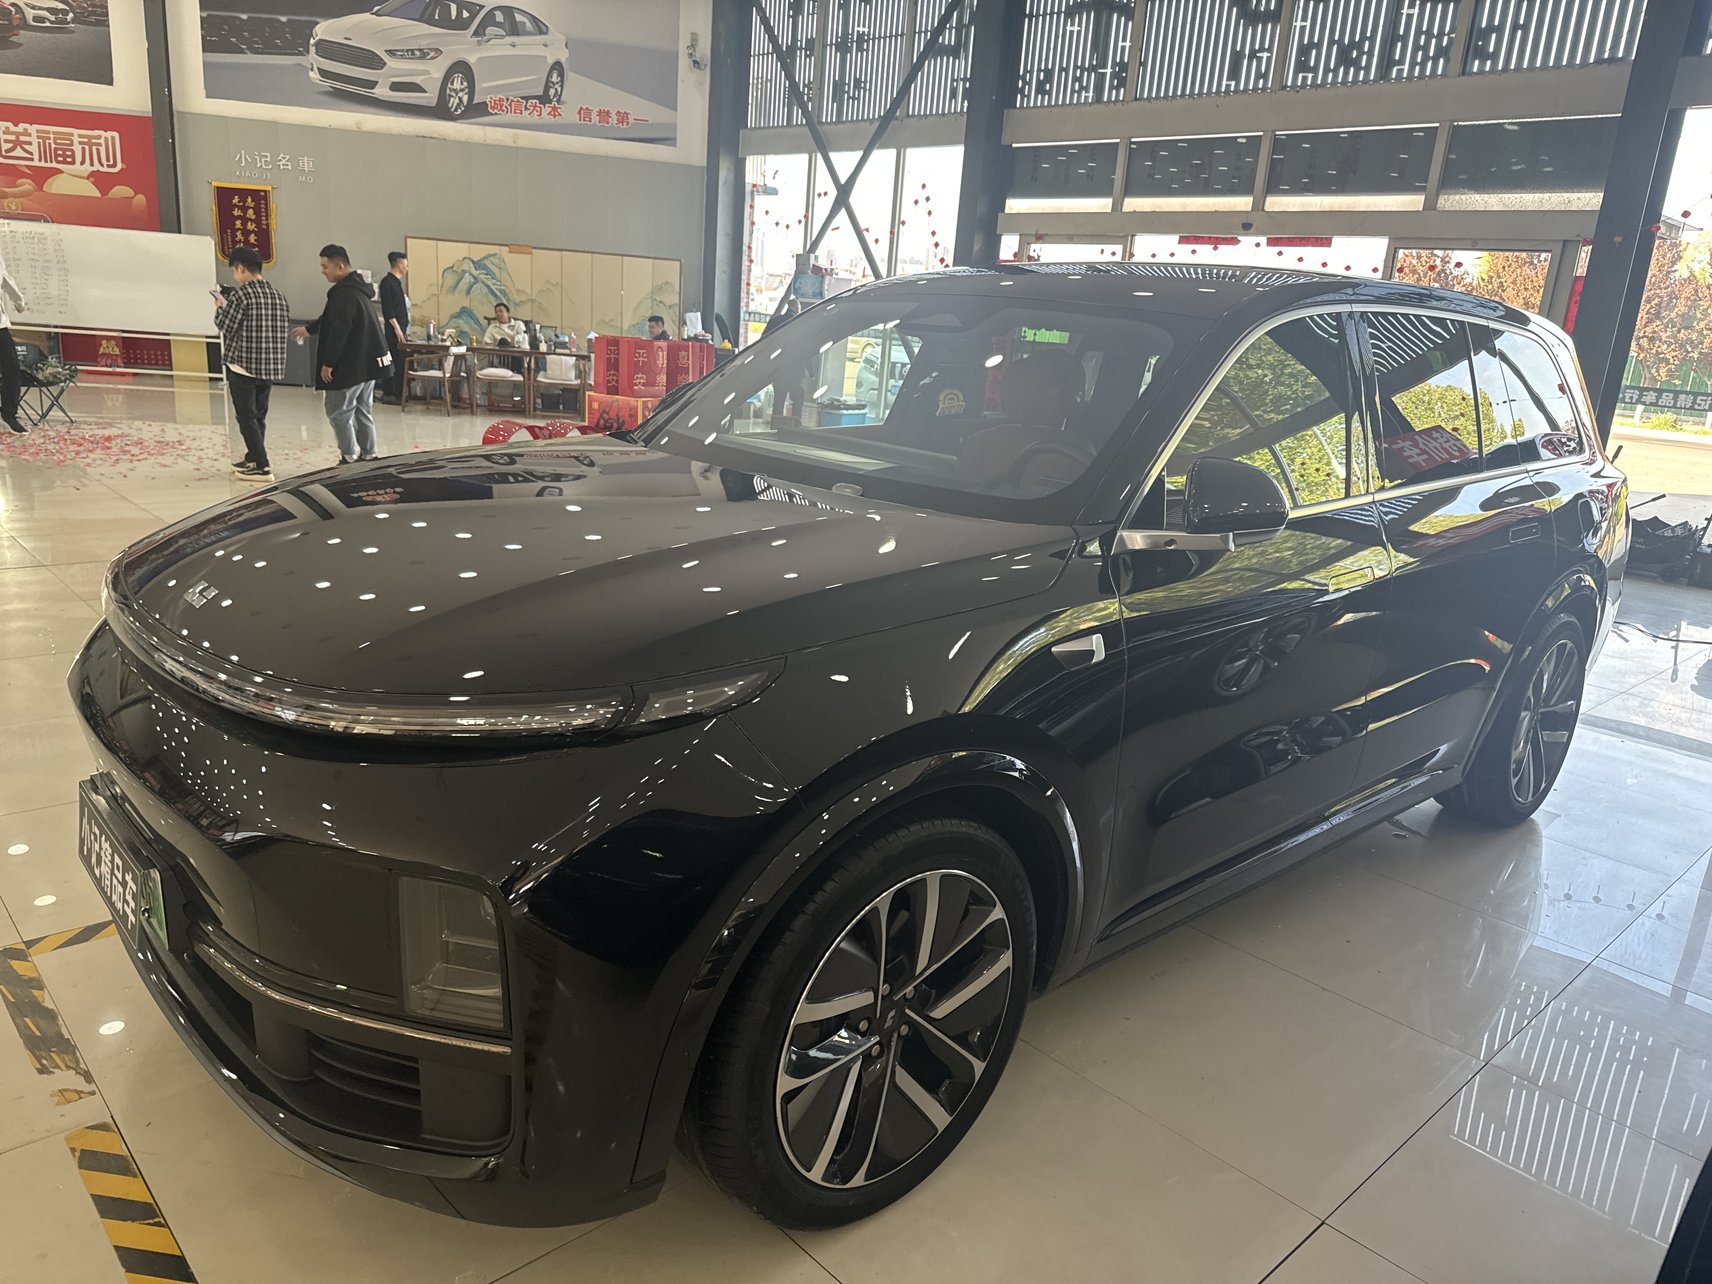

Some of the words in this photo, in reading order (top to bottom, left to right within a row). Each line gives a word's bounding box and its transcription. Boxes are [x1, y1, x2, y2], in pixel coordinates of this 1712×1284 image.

[488, 96, 563, 119] 诚信为本
[576, 106, 650, 127] 信誉第一
[0, 122, 119, 171] 送福利
[235, 150, 315, 173] 小记名車
[245, 195, 260, 252] 志愿献爱
[633, 349, 648, 389] 平安
[81, 807, 137, 930] 小记精品车
